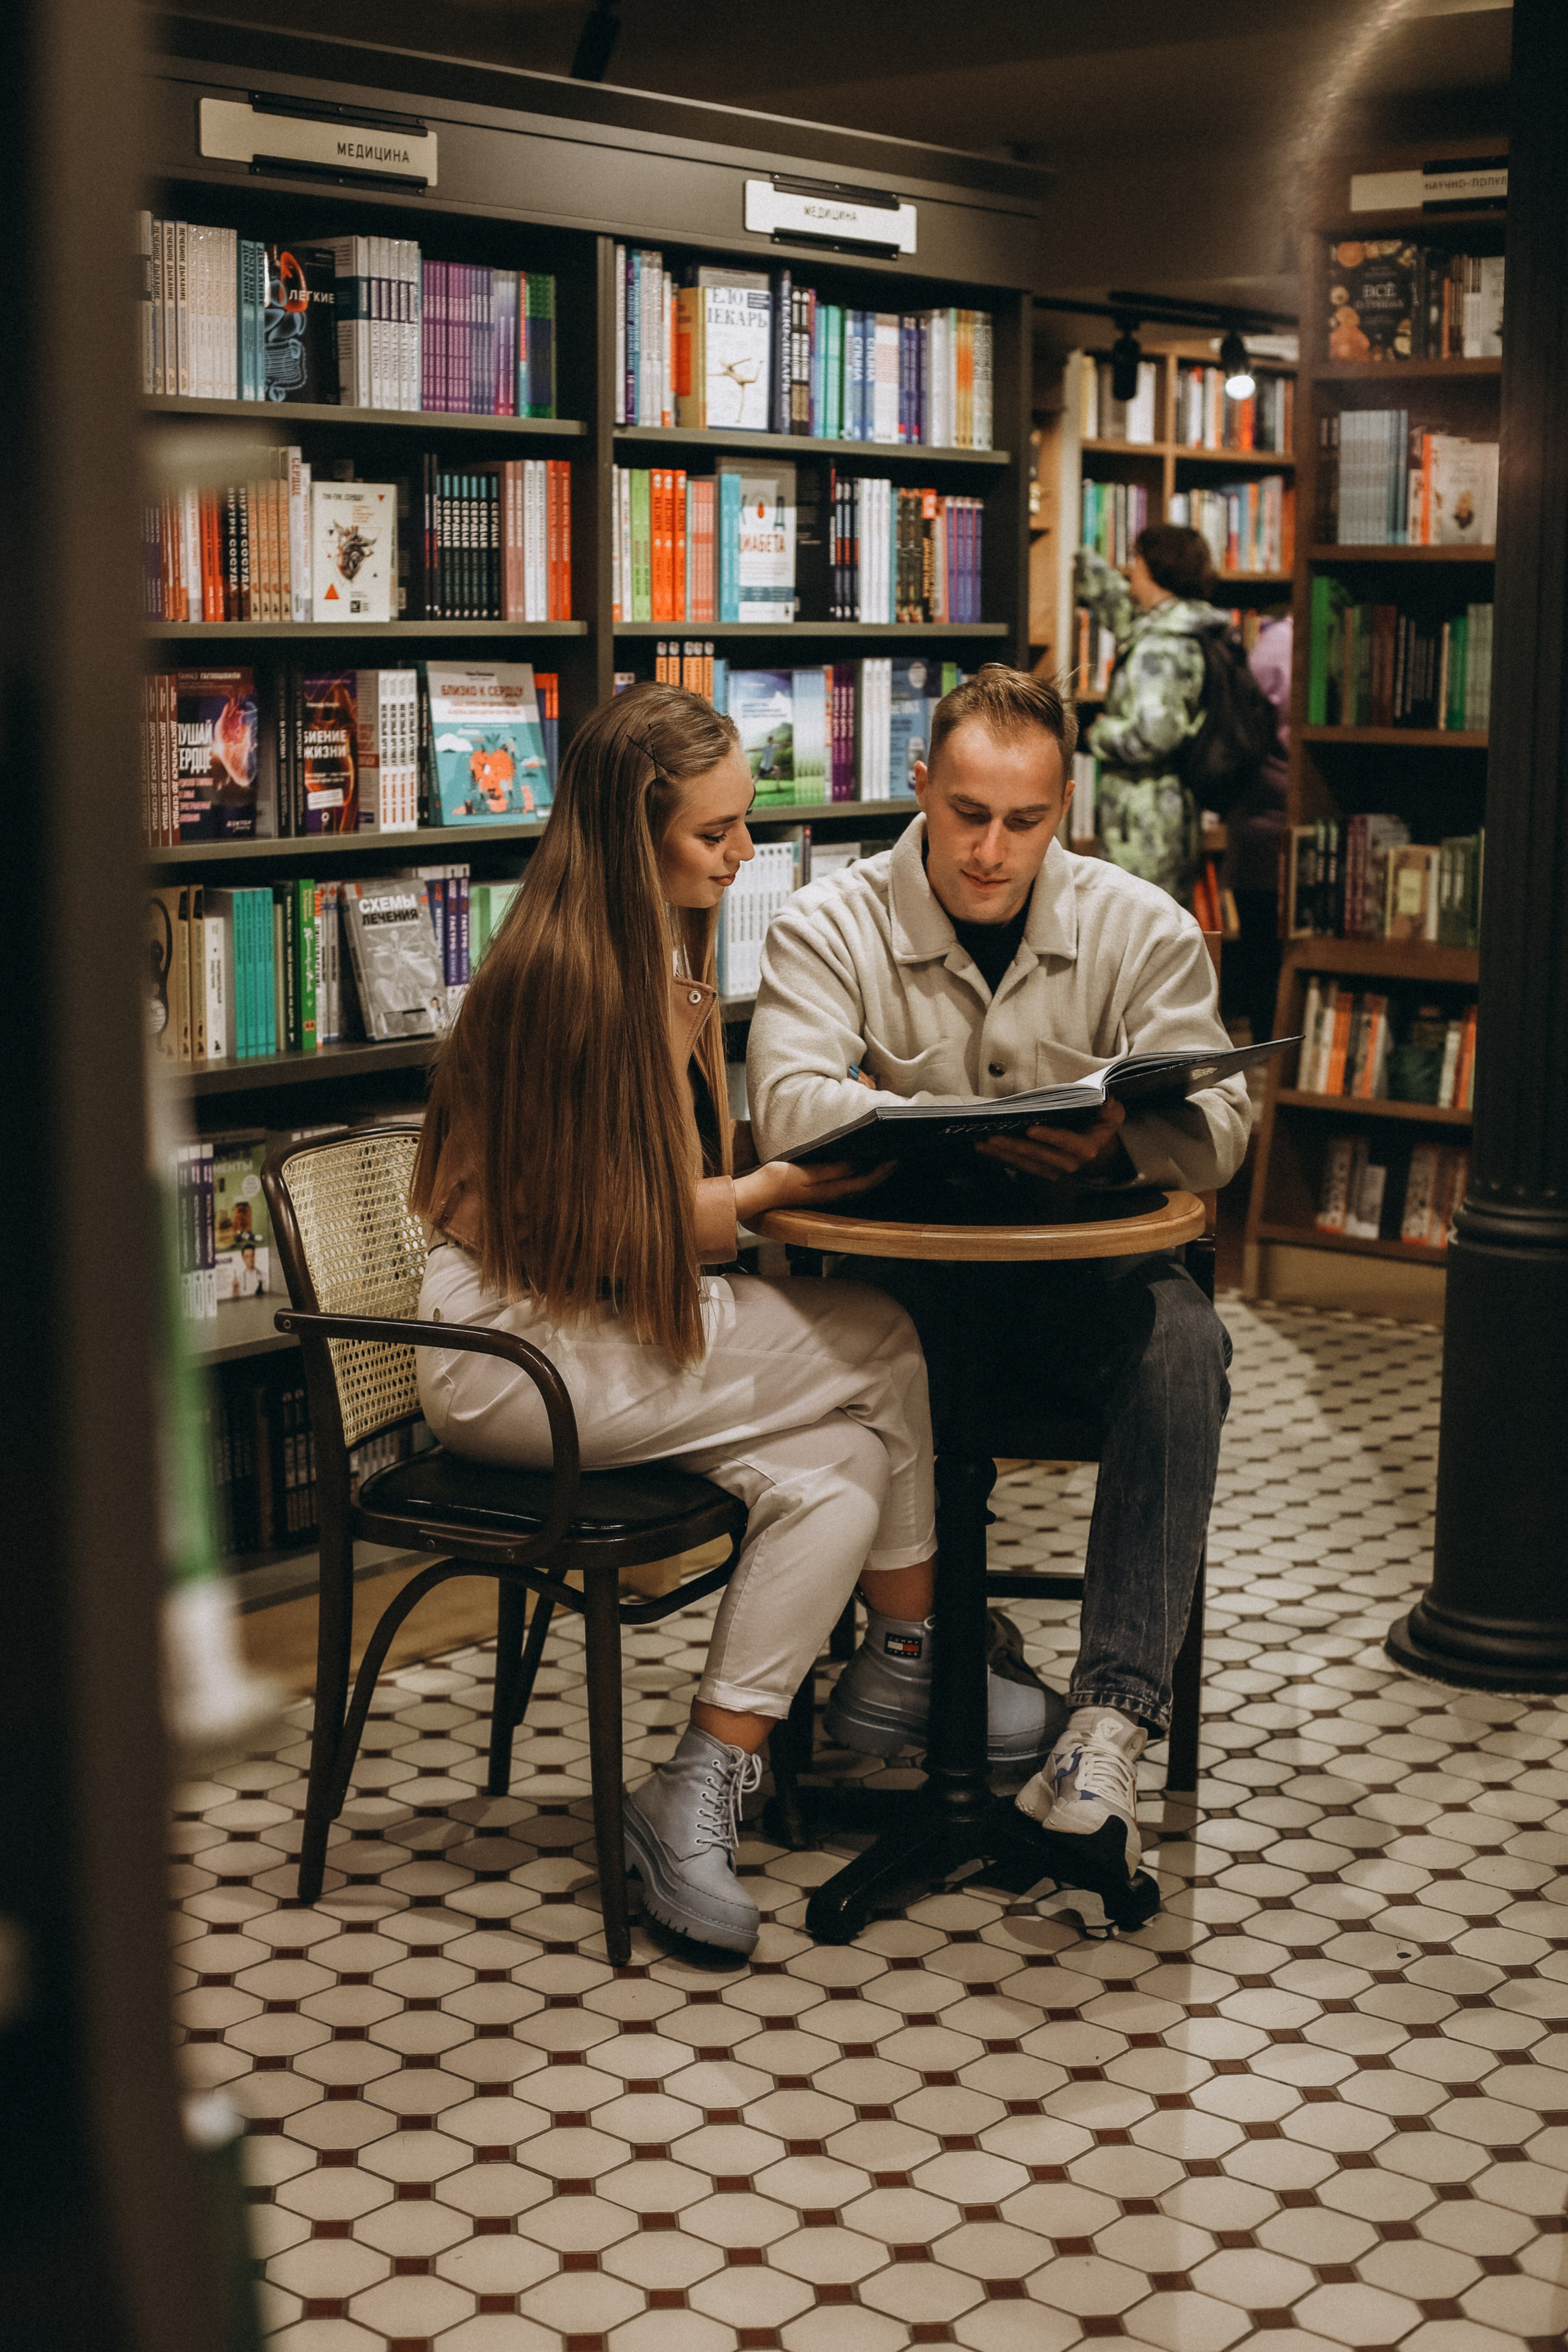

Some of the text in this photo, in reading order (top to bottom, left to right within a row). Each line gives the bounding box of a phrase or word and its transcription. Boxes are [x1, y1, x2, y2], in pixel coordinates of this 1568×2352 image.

[337, 141, 410, 164] МЕДИЦИНА
[804, 205, 858, 221] МЕДИЦИНА
[288, 288, 335, 304] ЛЕГКИЕ
[292, 456, 301, 497] СЕРДЦЕ
[229, 538, 238, 592] СОСУДА
[240, 538, 249, 592] СОСУДА
[170, 720, 178, 780] ДОСТУЧАТЬСЯ
[179, 746, 213, 774] ЕРДЦЕ
[358, 892, 418, 914] СХЕМЫ
[362, 909, 420, 926] ЛЕЧЕНИЯ
